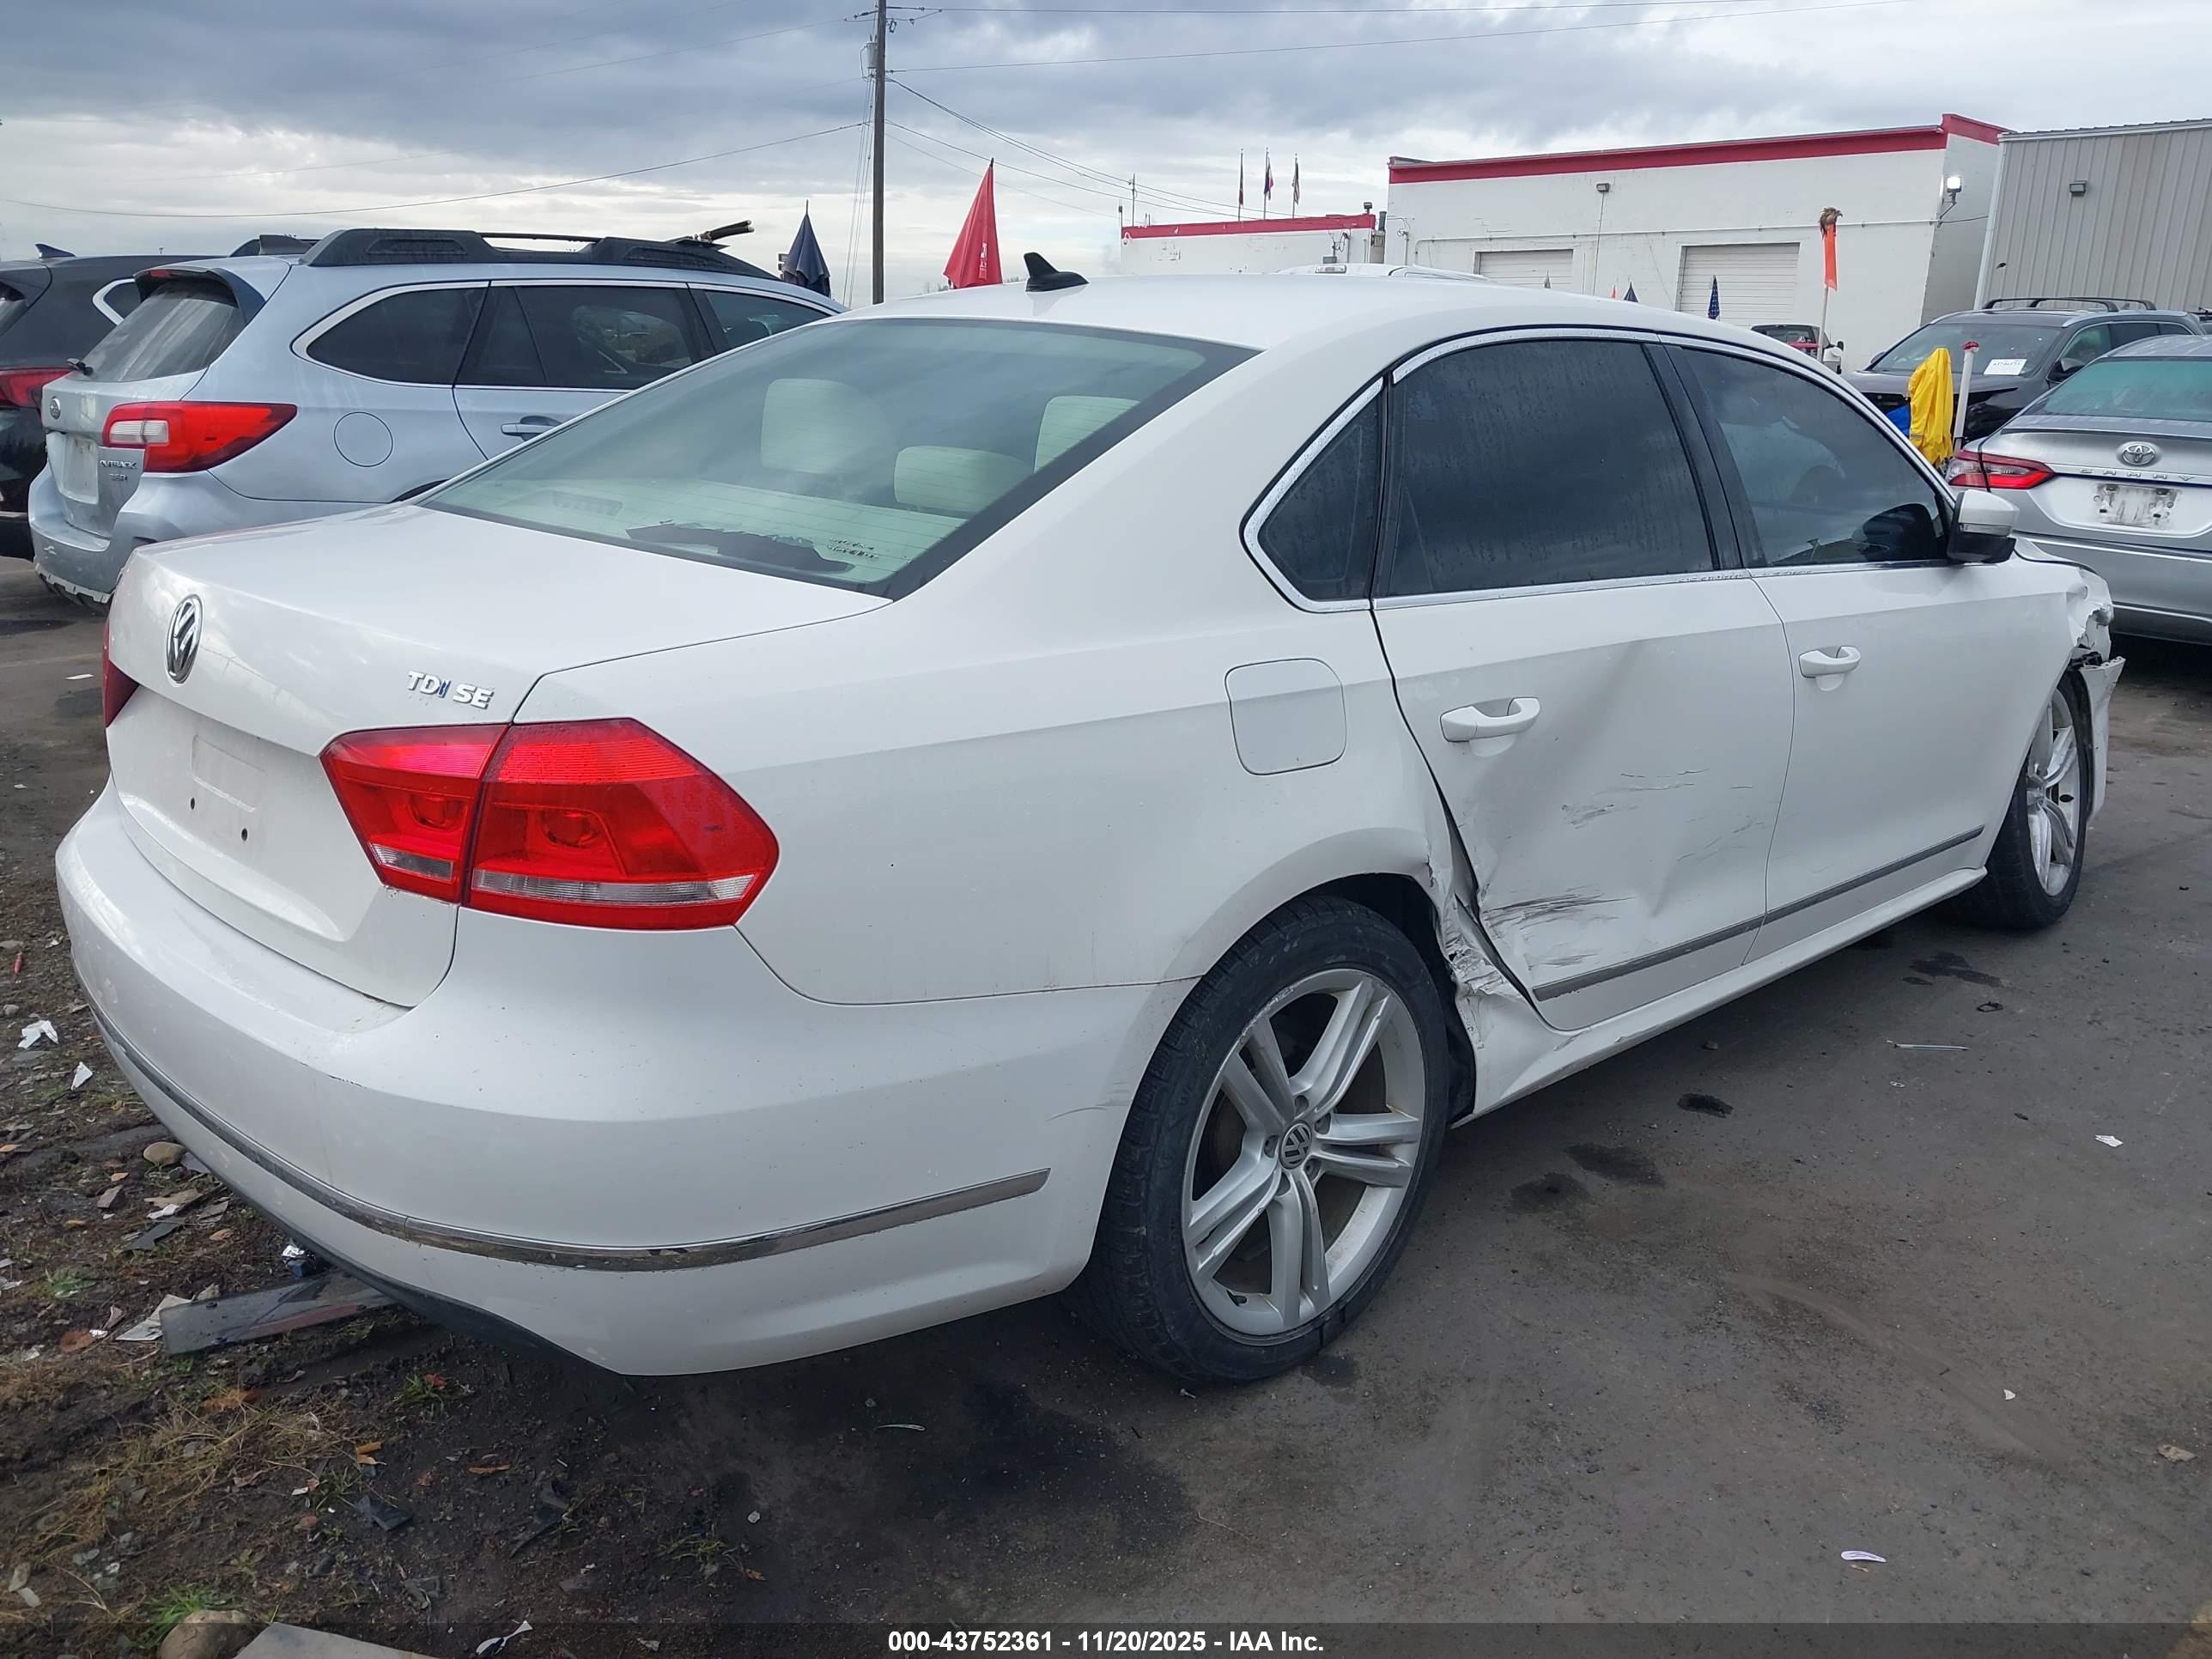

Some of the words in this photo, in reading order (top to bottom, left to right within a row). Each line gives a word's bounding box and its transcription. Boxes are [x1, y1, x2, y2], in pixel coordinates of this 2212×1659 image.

[2080, 468, 2195, 481] CAMRY
[407, 671, 452, 699] TDI
[453, 684, 495, 710] SE
